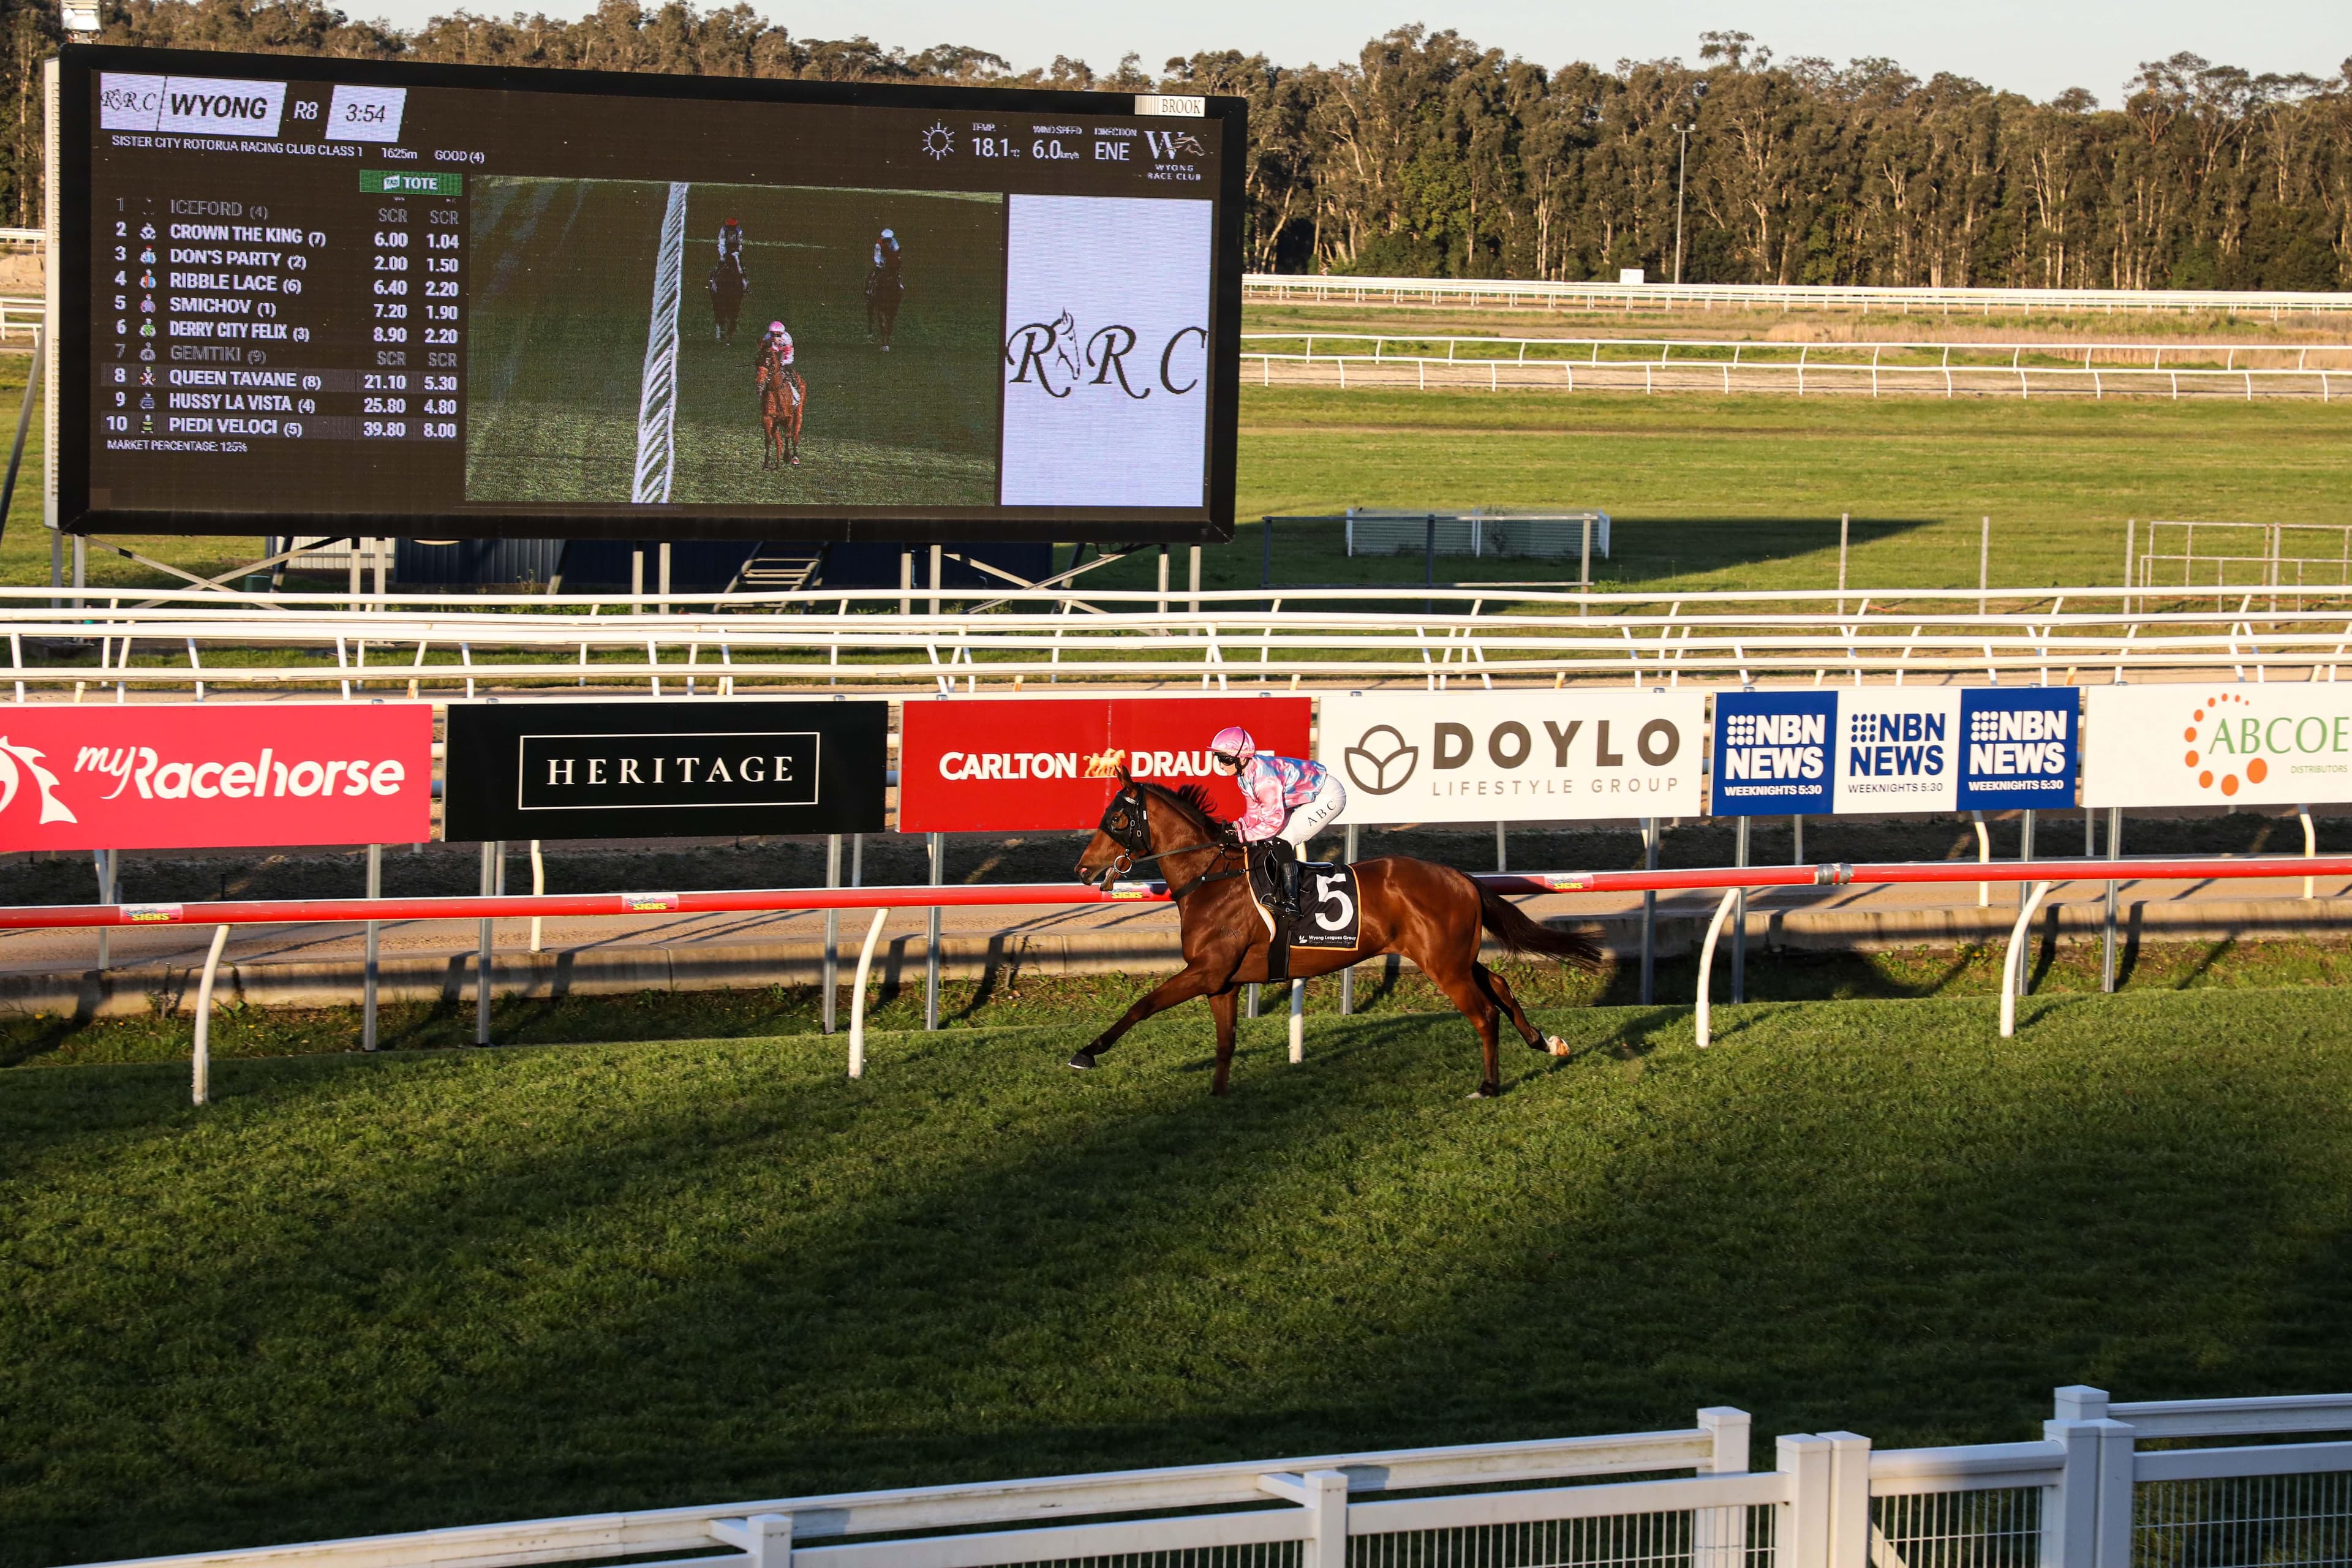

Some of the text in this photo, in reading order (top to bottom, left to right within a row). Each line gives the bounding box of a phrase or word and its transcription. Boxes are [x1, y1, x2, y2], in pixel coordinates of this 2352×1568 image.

[172, 93, 267, 119] WYONG
[293, 101, 318, 119] R8
[345, 104, 386, 123] 3:54
[1162, 99, 1201, 114] BROOK
[112, 135, 363, 157] SISTER CITY ROTORUA RACING CLUB CLASS 1
[382, 148, 418, 159] 1625m
[1095, 141, 1130, 160] ENE
[435, 150, 485, 164] GOOD (4)
[402, 177, 438, 190] TOTE
[116, 198, 124, 211] 1
[170, 200, 243, 216] ICEFORD
[379, 208, 407, 222] SCR
[430, 210, 459, 224] SCR
[115, 221, 127, 236] 2
[170, 224, 326, 247] CROWN THE KING (7)
[374, 232, 409, 247] 6.00
[426, 233, 459, 249] 1.04
[115, 246, 127, 261] 3
[170, 248, 307, 270] DON'S PARTY (2)
[374, 255, 408, 271] 2.00
[427, 258, 458, 273] 1.50
[115, 271, 127, 285] 4
[170, 272, 302, 295] RIBBLE LACE (6)
[374, 280, 408, 295] 6.40
[425, 281, 459, 297] 2.20
[115, 295, 127, 310] 5
[170, 296, 277, 318] SMICHOV (1)
[374, 304, 407, 319] 7.20
[426, 305, 459, 320] 1.90
[116, 319, 127, 334] 6
[169, 320, 311, 342] DERRY CITY FELIX (3)
[373, 326, 407, 342] 8.90
[424, 328, 458, 344] 2.20
[115, 344, 126, 358] 7
[170, 345, 241, 362] GEMTIKI
[377, 351, 407, 366] SCR
[428, 352, 457, 368] SCR
[114, 368, 126, 383] 8
[169, 369, 322, 391] QUEEN TAVANE (8)
[364, 374, 407, 390] 21.10
[424, 376, 458, 391] 5.30
[115, 392, 126, 407] 9
[169, 393, 316, 414] HUSSY LA VISTA (4)
[363, 398, 406, 413] 25.80
[423, 399, 457, 415] 4.80
[106, 416, 127, 431] 10
[169, 417, 303, 437] PIEDI VELOCI (5)
[363, 421, 406, 437] 39.80
[423, 423, 457, 438] 8.00
[107, 439, 149, 450] MARKET
[151, 440, 217, 451] PERCENTAGE:
[1755, 714, 1825, 745] NBN
[1880, 713, 1945, 742] NBN
[1999, 710, 2067, 741] NBN
[1433, 718, 1680, 769] DOYLO
[939, 750, 1275, 780] CARLTON DRAU
[1725, 746, 1824, 780] NEWS
[1850, 744, 1943, 776] NEWS
[1969, 742, 2066, 775] NEWS
[74, 746, 405, 800] myRacehorse
[547, 756, 793, 785] HERITAGE
[2291, 765, 2348, 774] DISTRIBUTORS
[1433, 777, 1678, 796] LIFESTYLE GROUP
[1724, 785, 1822, 796] WEEKNIGHTS 5:30
[1848, 783, 1943, 793] WEEKNIGHTS 5:30
[1969, 780, 2064, 791] WEEKNIGHTS 5:30
[633, 902, 667, 911] SIGNS
[1314, 873, 1354, 931] 5
[131, 913, 170, 921] SIGNS
